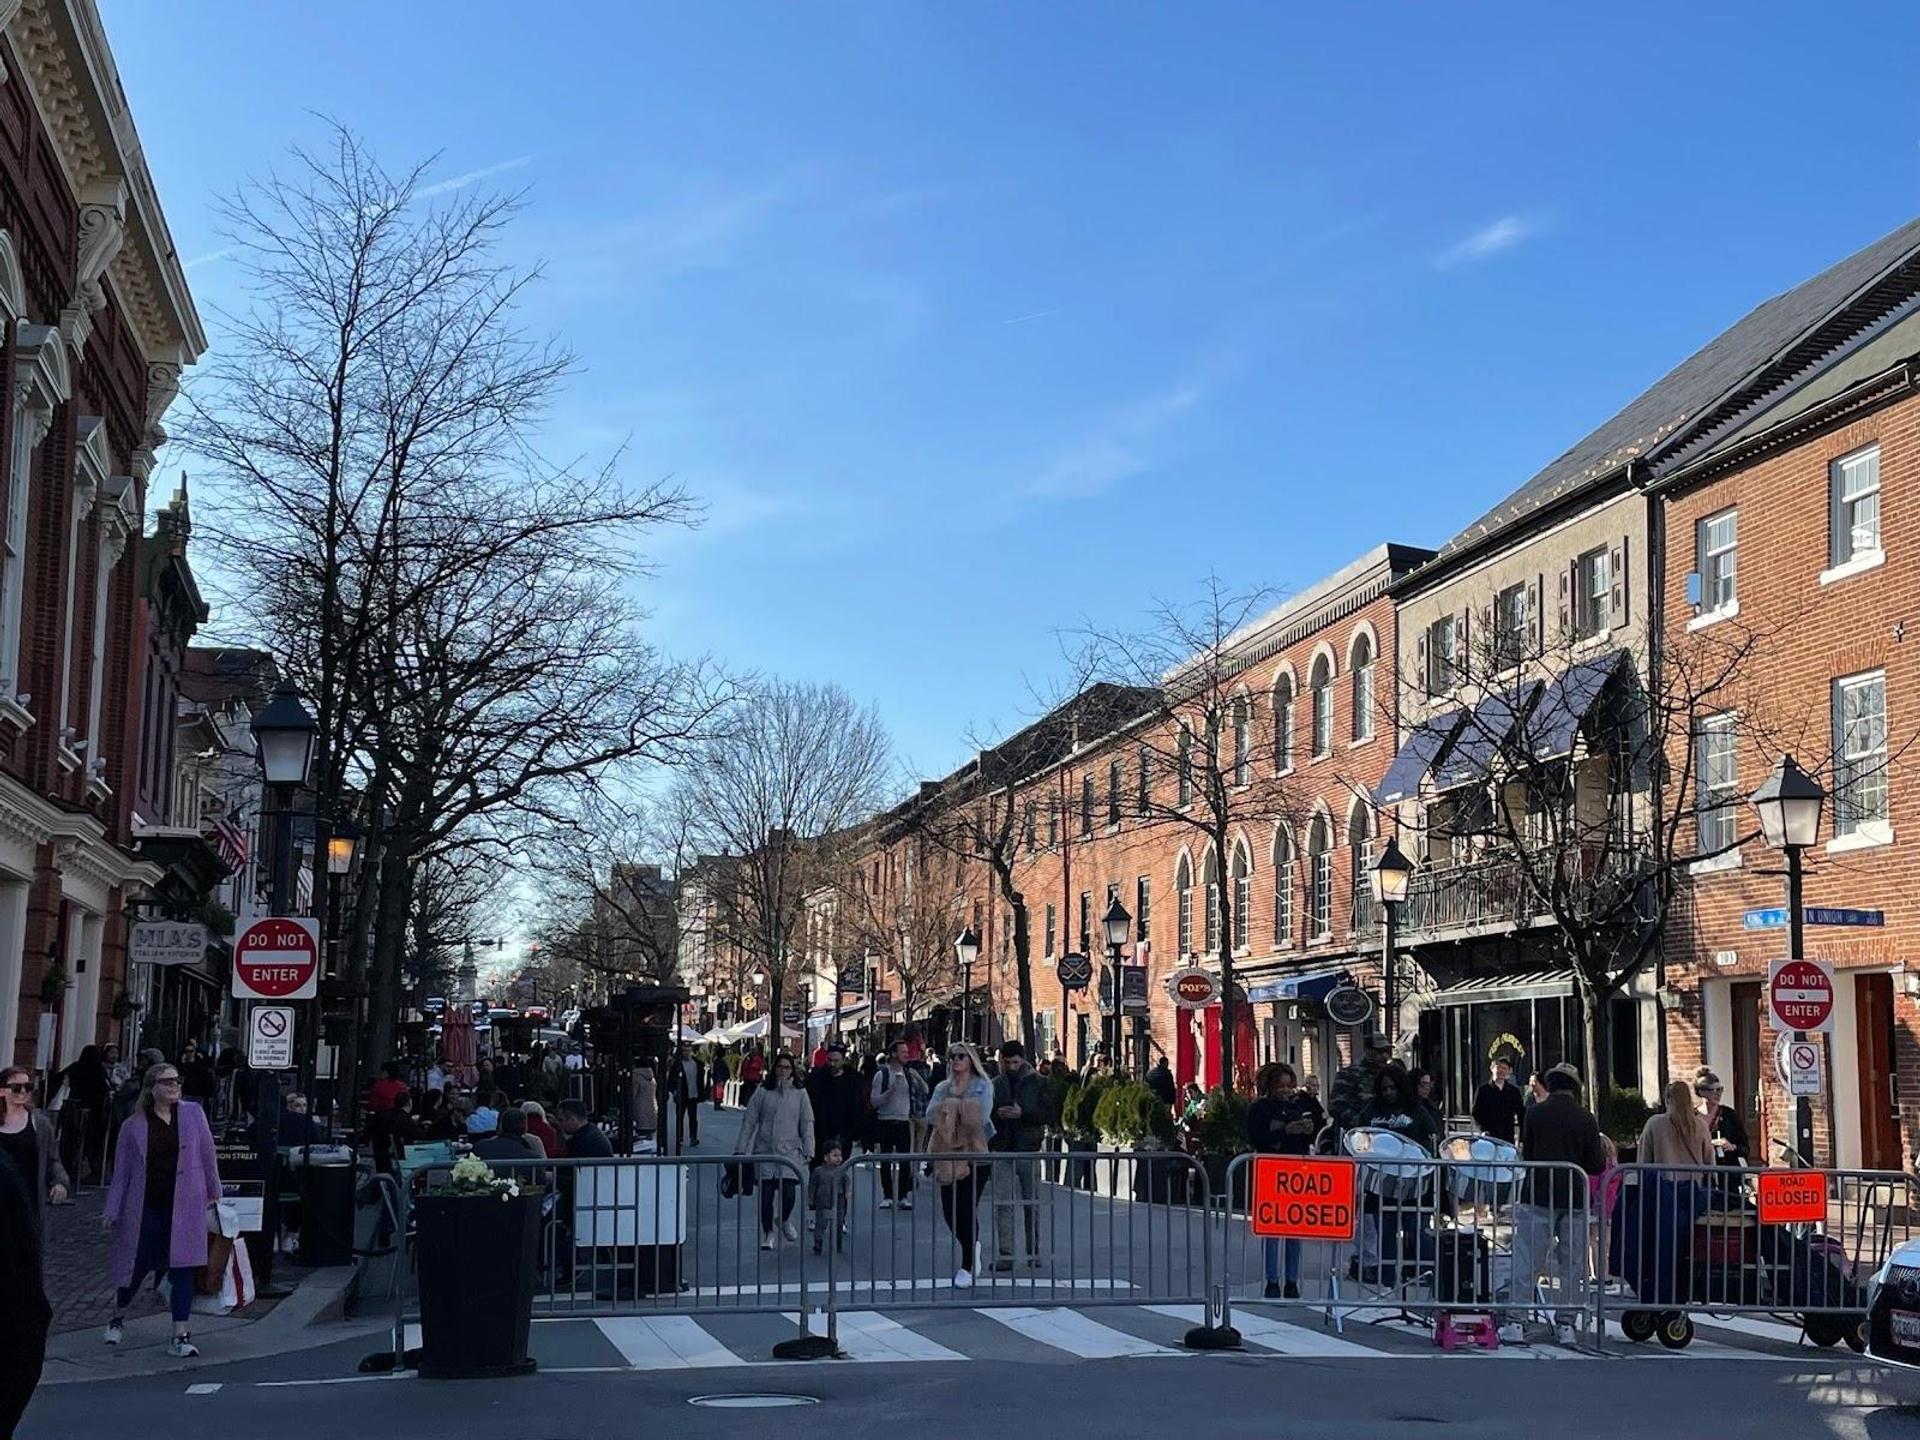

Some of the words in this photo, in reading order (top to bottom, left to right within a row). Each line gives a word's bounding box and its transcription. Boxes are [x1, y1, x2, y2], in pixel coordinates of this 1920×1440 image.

[248, 933, 268, 947] DO
[277, 933, 306, 947] NOT
[252, 968, 299, 982] ENTER
[1780, 974, 1795, 986] DO
[1801, 974, 1824, 987] NOT
[1785, 1004, 1821, 1017] ENTER
[1276, 1171, 1333, 1196] ROAD
[1779, 1176, 1806, 1188] ROAD
[1765, 1189, 1820, 1206] CLOSED
[1258, 1202, 1350, 1227] CLOSED
